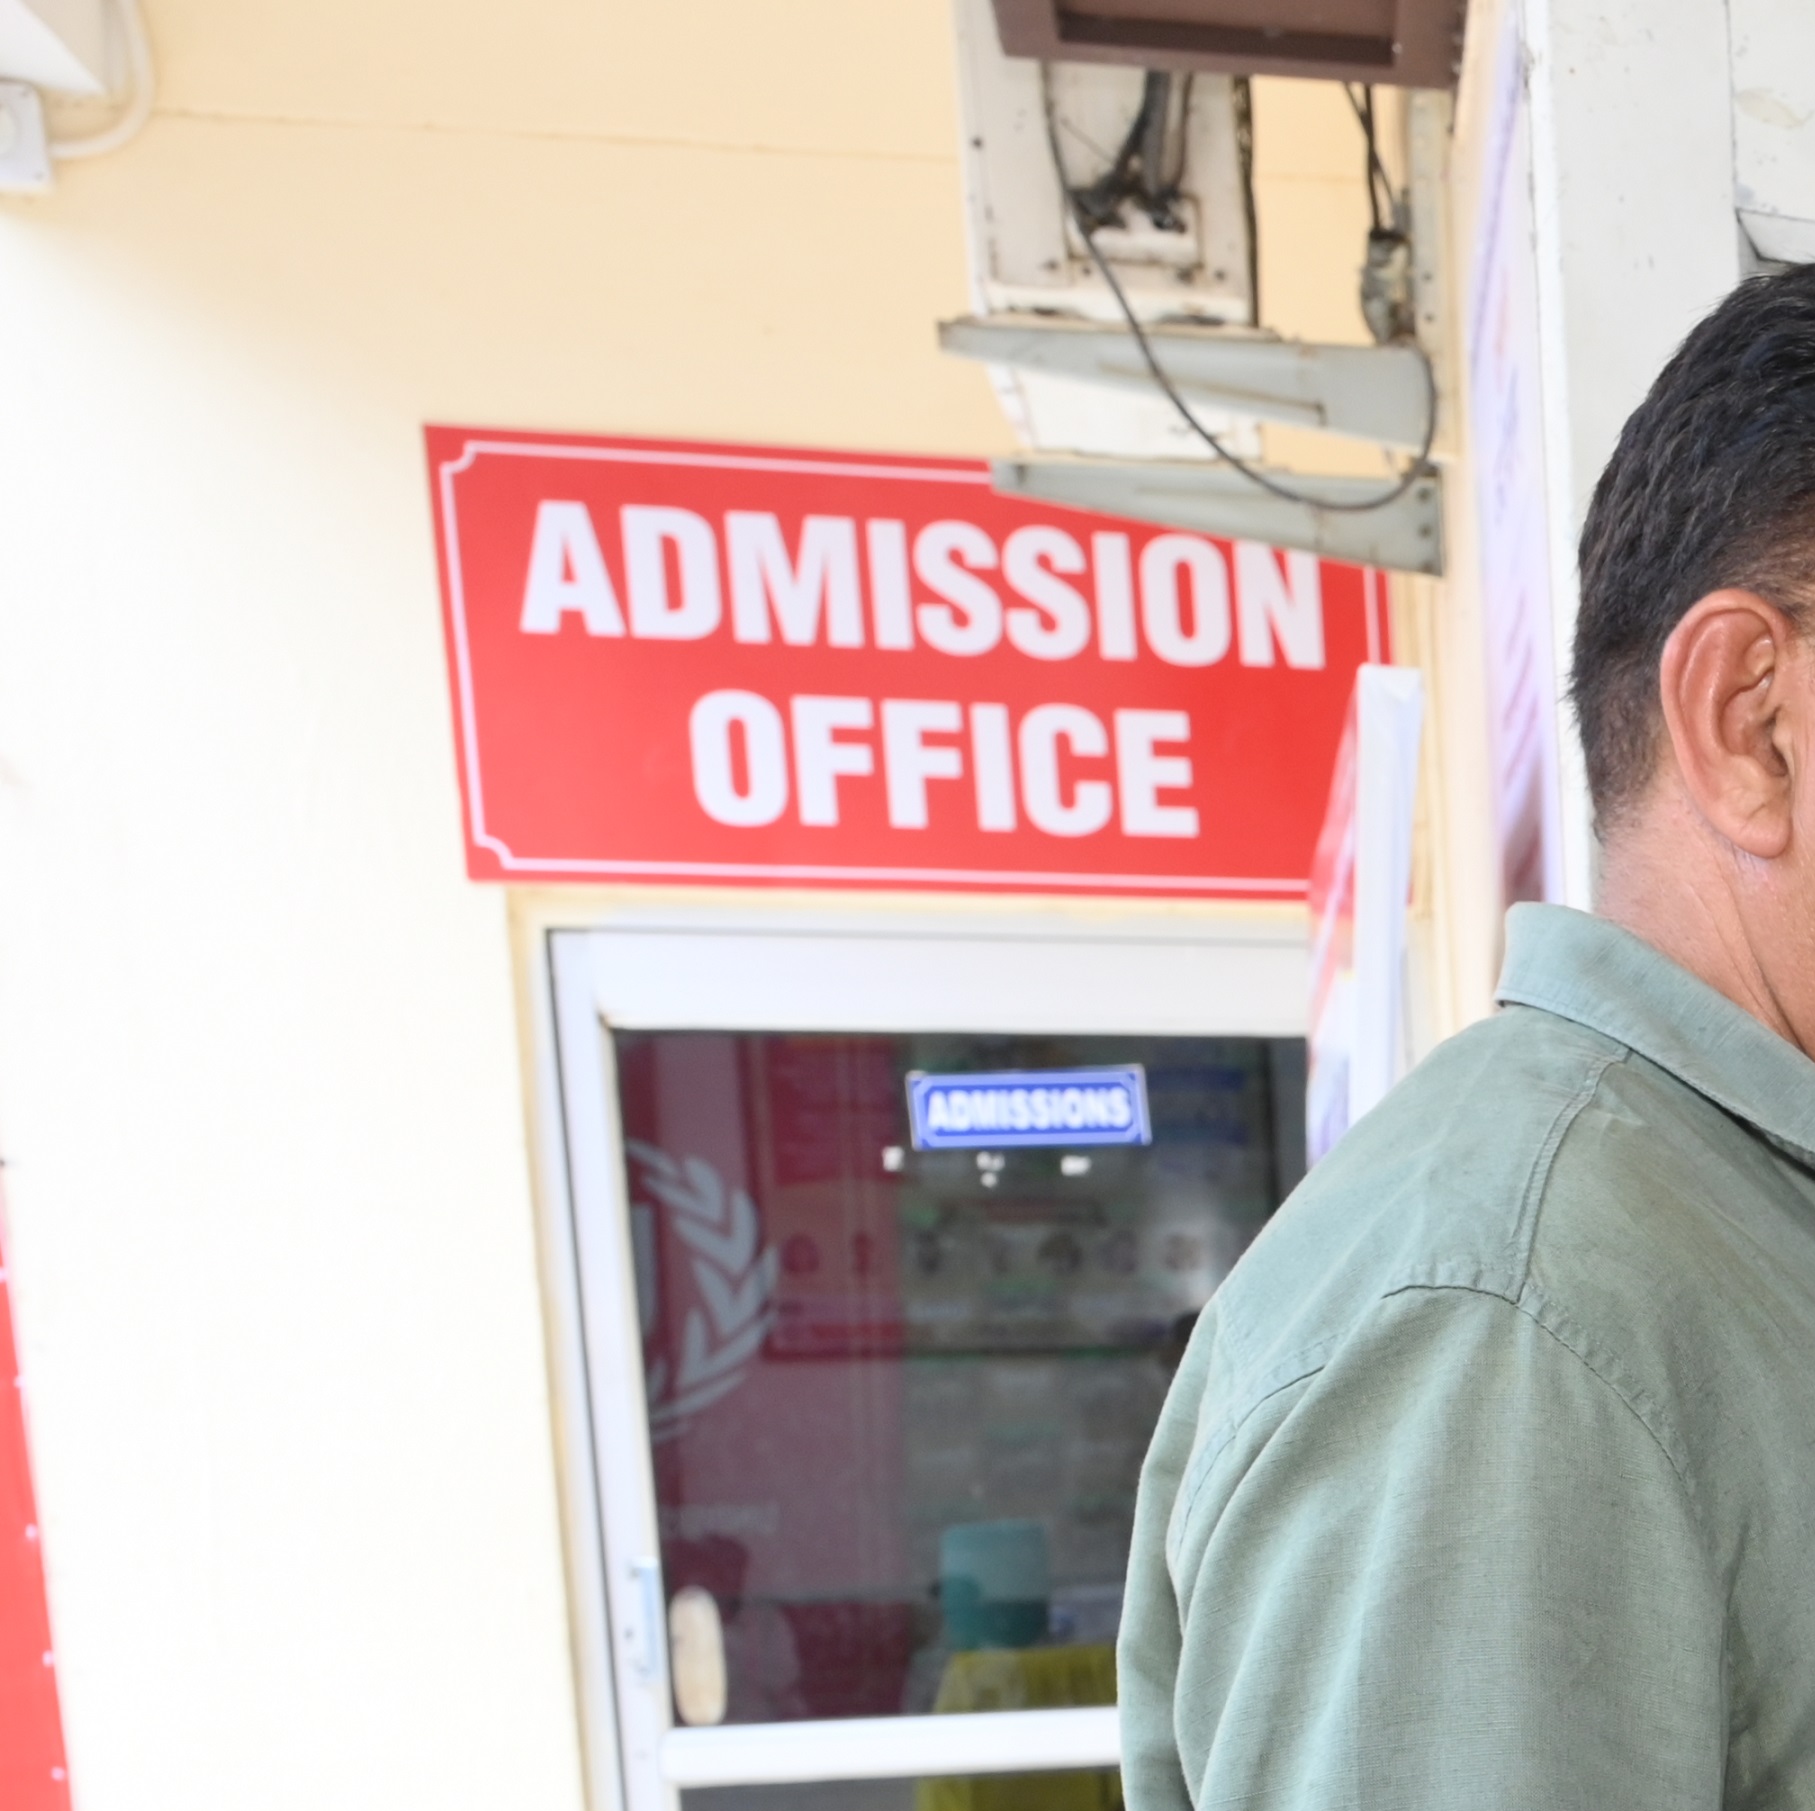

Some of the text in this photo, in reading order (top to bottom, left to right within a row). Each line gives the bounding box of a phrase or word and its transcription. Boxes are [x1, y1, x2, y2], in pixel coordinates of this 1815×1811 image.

[520, 499, 1325, 670] ADMISSION
[688, 688, 1200, 838] OFFICE
[925, 1083, 1132, 1133] ADMISSIONS
